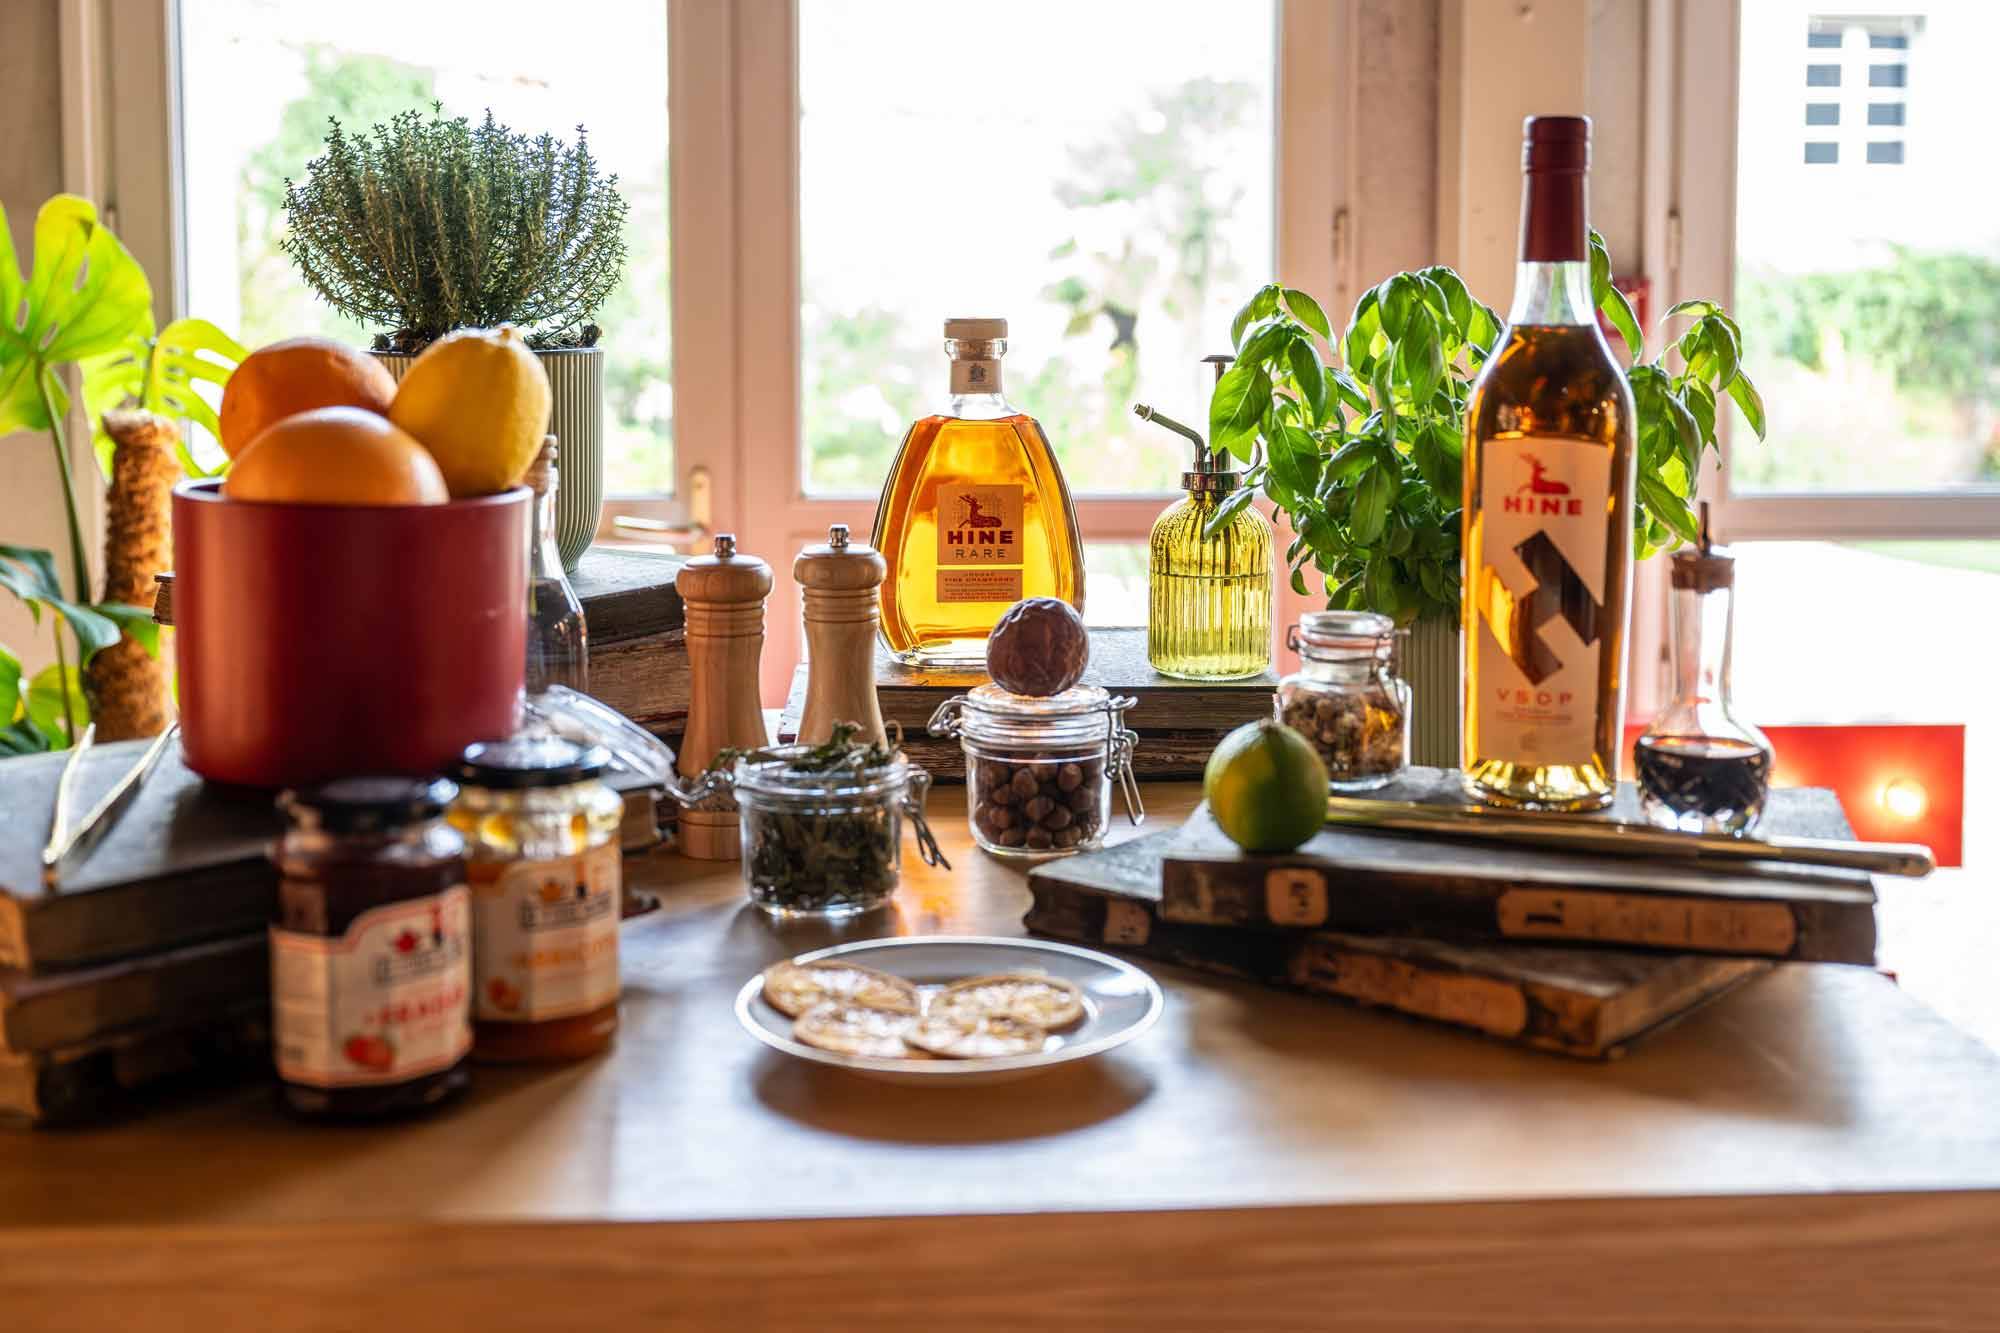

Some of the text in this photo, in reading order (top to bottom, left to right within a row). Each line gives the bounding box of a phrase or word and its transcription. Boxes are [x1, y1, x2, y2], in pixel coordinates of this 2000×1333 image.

[1503, 496, 1583, 516] HINE
[947, 530, 1014, 545] HINE
[955, 548, 1006, 559] RARE
[1496, 688, 1574, 706] VSOP
